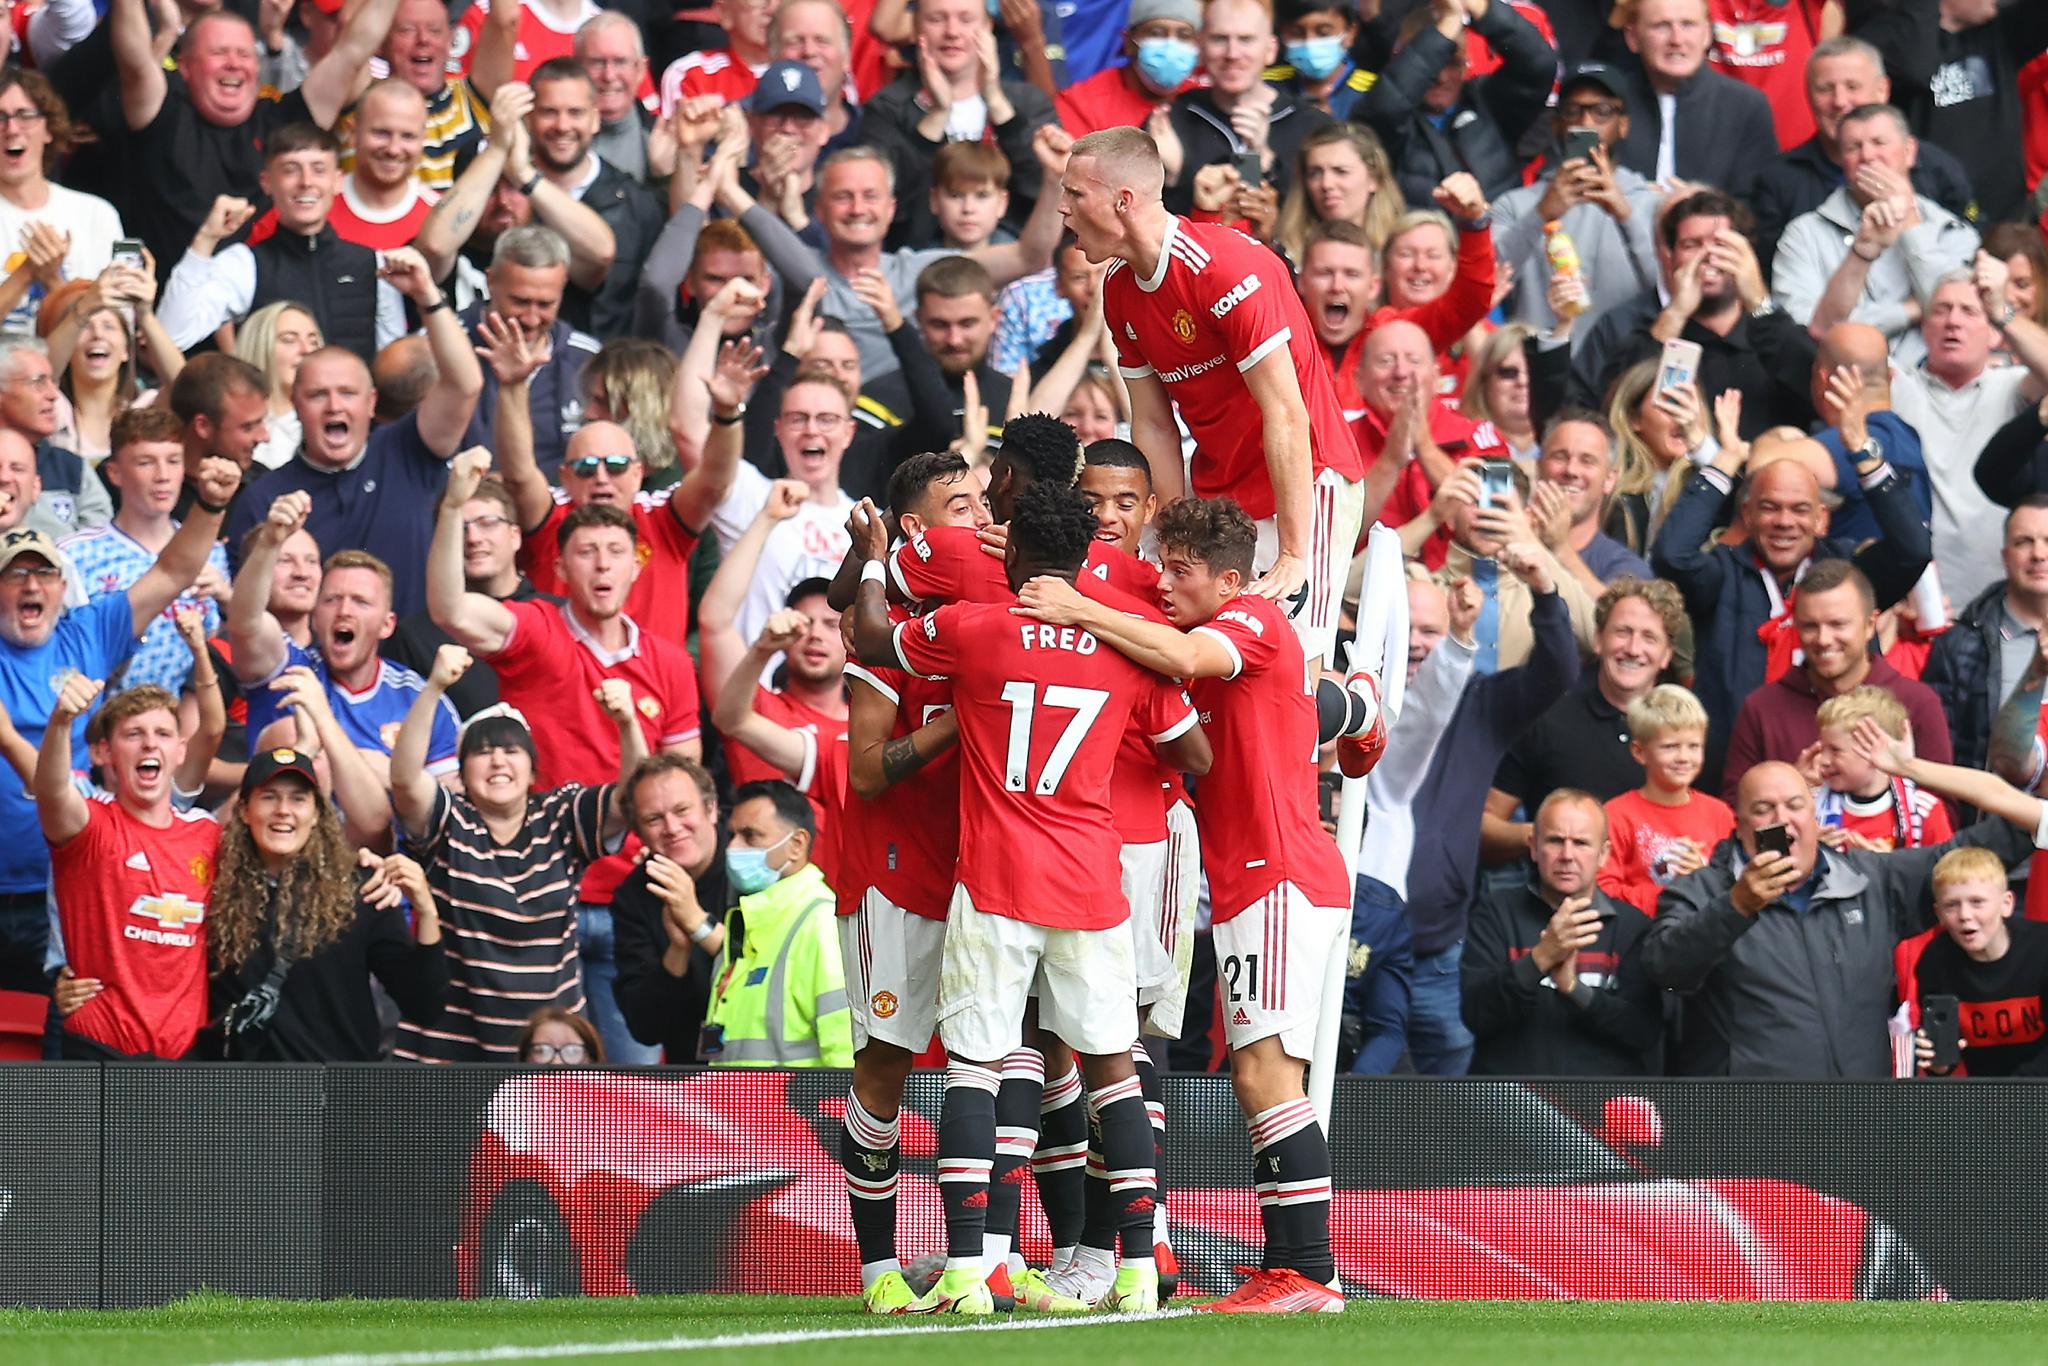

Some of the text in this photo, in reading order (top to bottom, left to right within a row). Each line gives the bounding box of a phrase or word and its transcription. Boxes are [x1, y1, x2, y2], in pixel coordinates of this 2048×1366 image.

[1210, 273, 1262, 319] KOHLER
[1156, 353, 1228, 383] amViewer
[1021, 625, 1098, 656] FRED
[1000, 681, 1110, 795] 17
[124, 925, 196, 947] CHEVROL
[1224, 955, 1258, 1002] 21
[1971, 1006, 2040, 1038] CON
